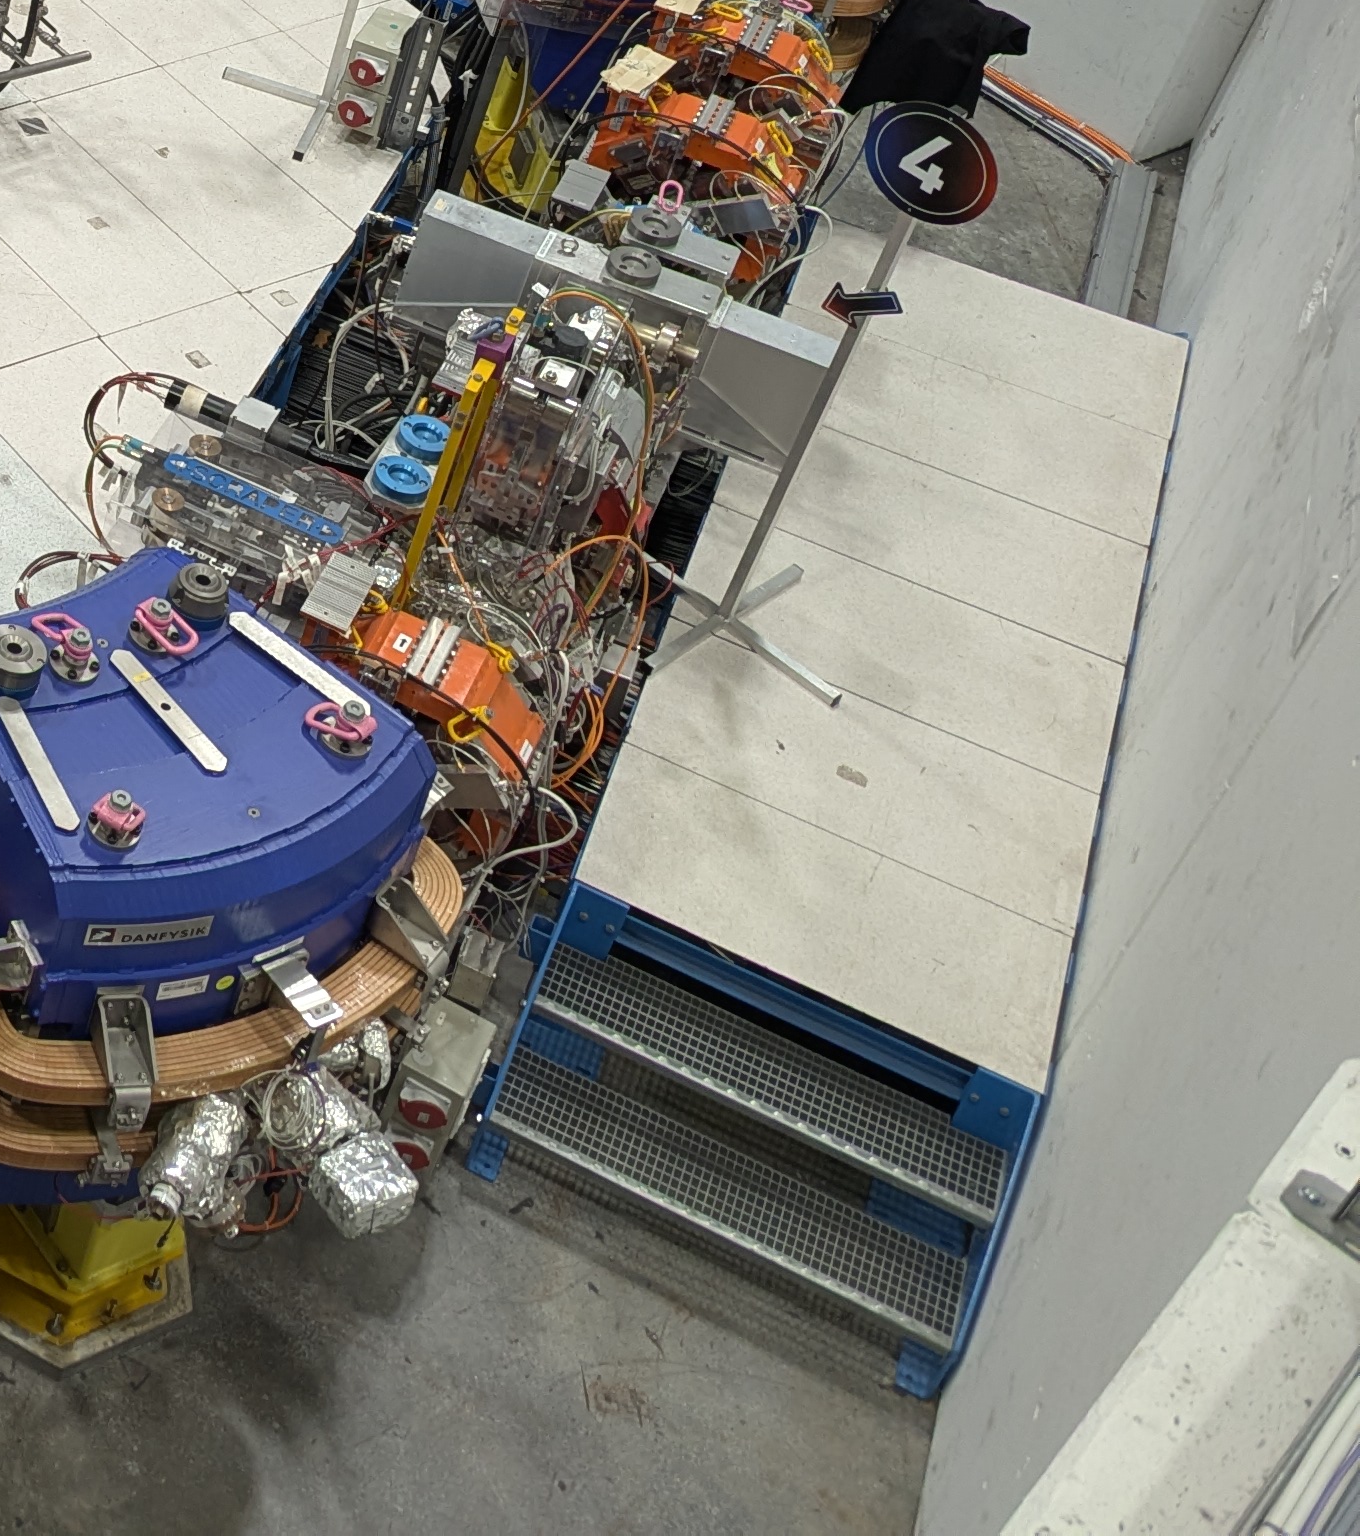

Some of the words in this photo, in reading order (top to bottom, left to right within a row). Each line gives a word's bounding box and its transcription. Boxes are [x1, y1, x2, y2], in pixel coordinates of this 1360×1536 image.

[899, 136, 951, 194] 4
[189, 465, 316, 531] SCRAPER
[121, 926, 206, 943] DANFYSIK
